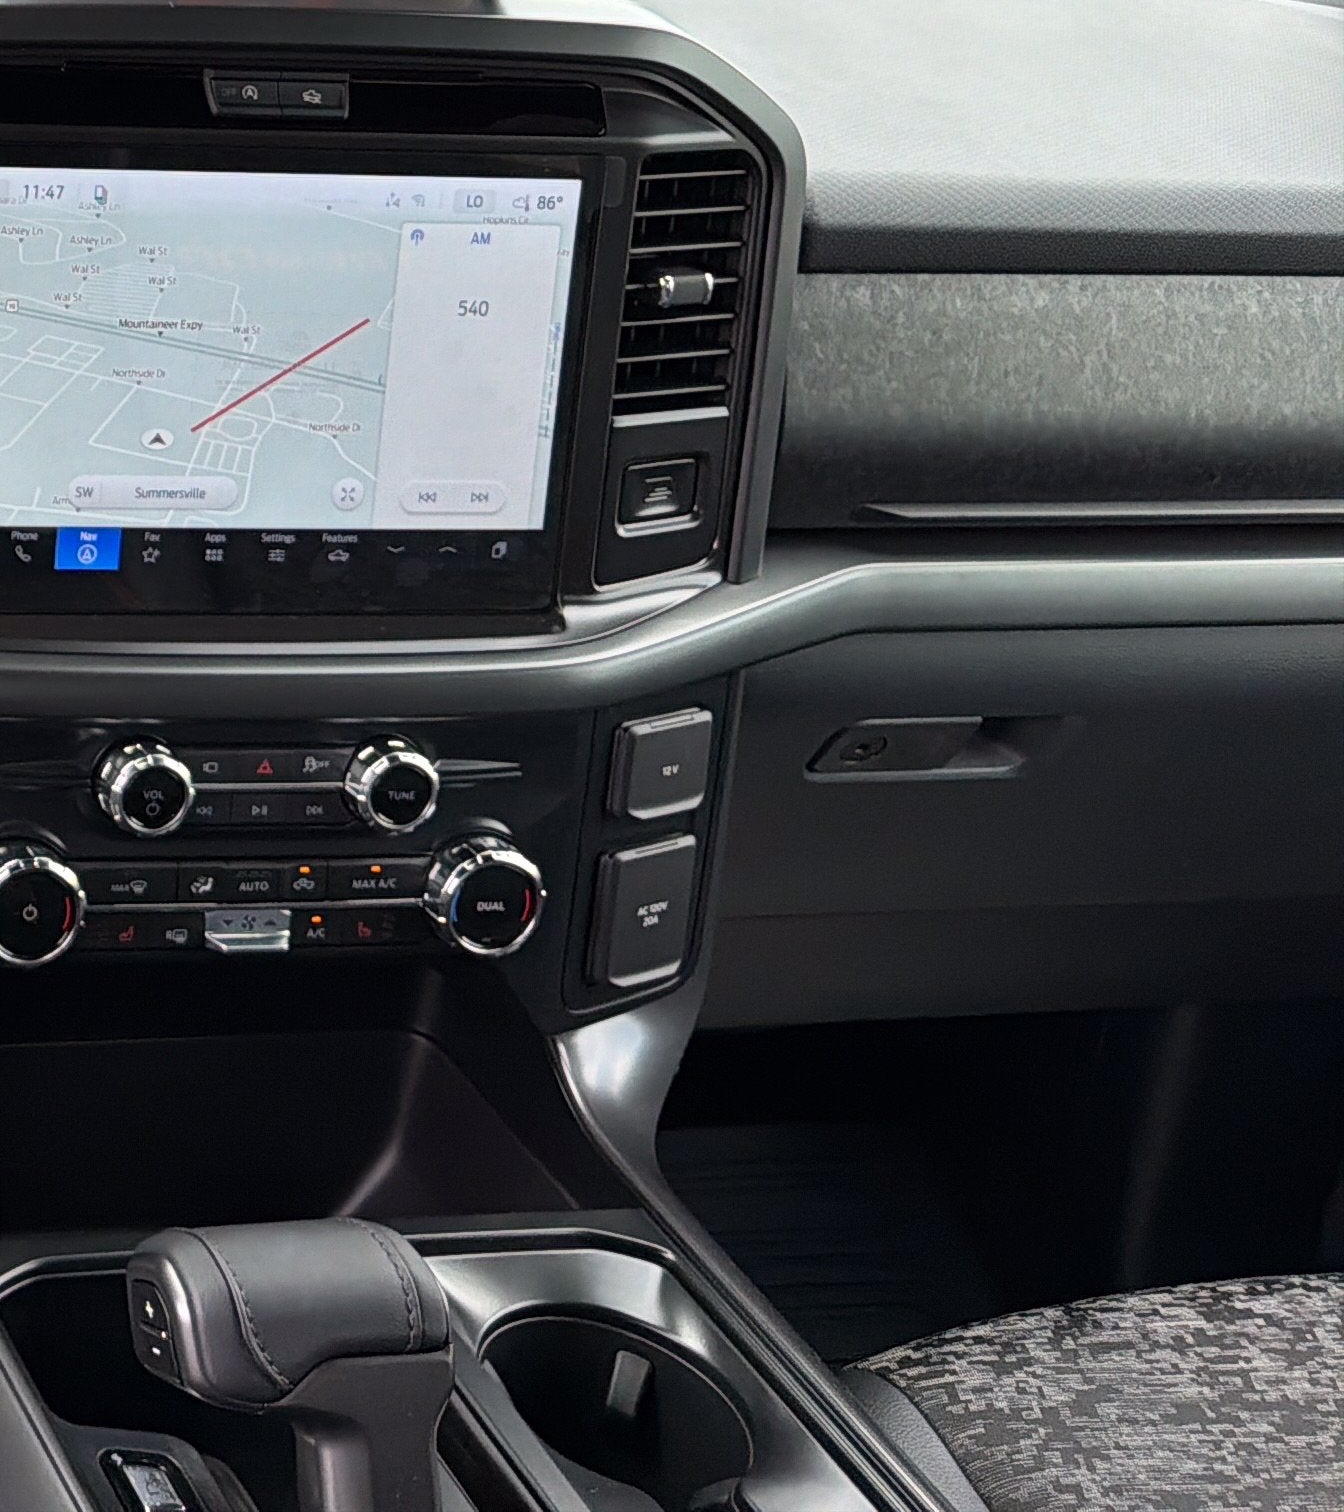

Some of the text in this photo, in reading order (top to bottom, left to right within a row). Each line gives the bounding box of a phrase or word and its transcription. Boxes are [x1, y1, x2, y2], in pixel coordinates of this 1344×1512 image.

[24, 185, 64, 199] 11:47
[466, 195, 484, 208] LO
[537, 196, 563, 210] 86°
[1, 226, 44, 237] Ashley Ln
[70, 235, 112, 246] Ashley Ln
[471, 232, 491, 245] AM
[138, 246, 167, 256] Wal St
[71, 265, 100, 274] Wal St
[148, 276, 177, 285] Wal St
[53, 293, 82, 302] Wal St
[457, 300, 489, 317] 540
[118, 319, 203, 331] Mountaineer Expy
[251, 325, 261, 335] St
[112, 369, 154, 378] Northside
[309, 423, 350, 432] Northside
[75, 487, 94, 498] SW
[134, 487, 206, 500] Summersville
[11, 530, 38, 541] Phone
[80, 531, 98, 541] Nav
[144, 531, 160, 541] Fav
[205, 532, 226, 544] Apps
[261, 532, 296, 544] Settings
[322, 533, 358, 543] Features
[143, 790, 164, 801] VOL
[387, 790, 416, 801] TUNE
[239, 881, 269, 892] AUTO
[352, 878, 396, 889] MAX A/C
[477, 901, 505, 912] DUAL
[307, 928, 325, 938] A/C
